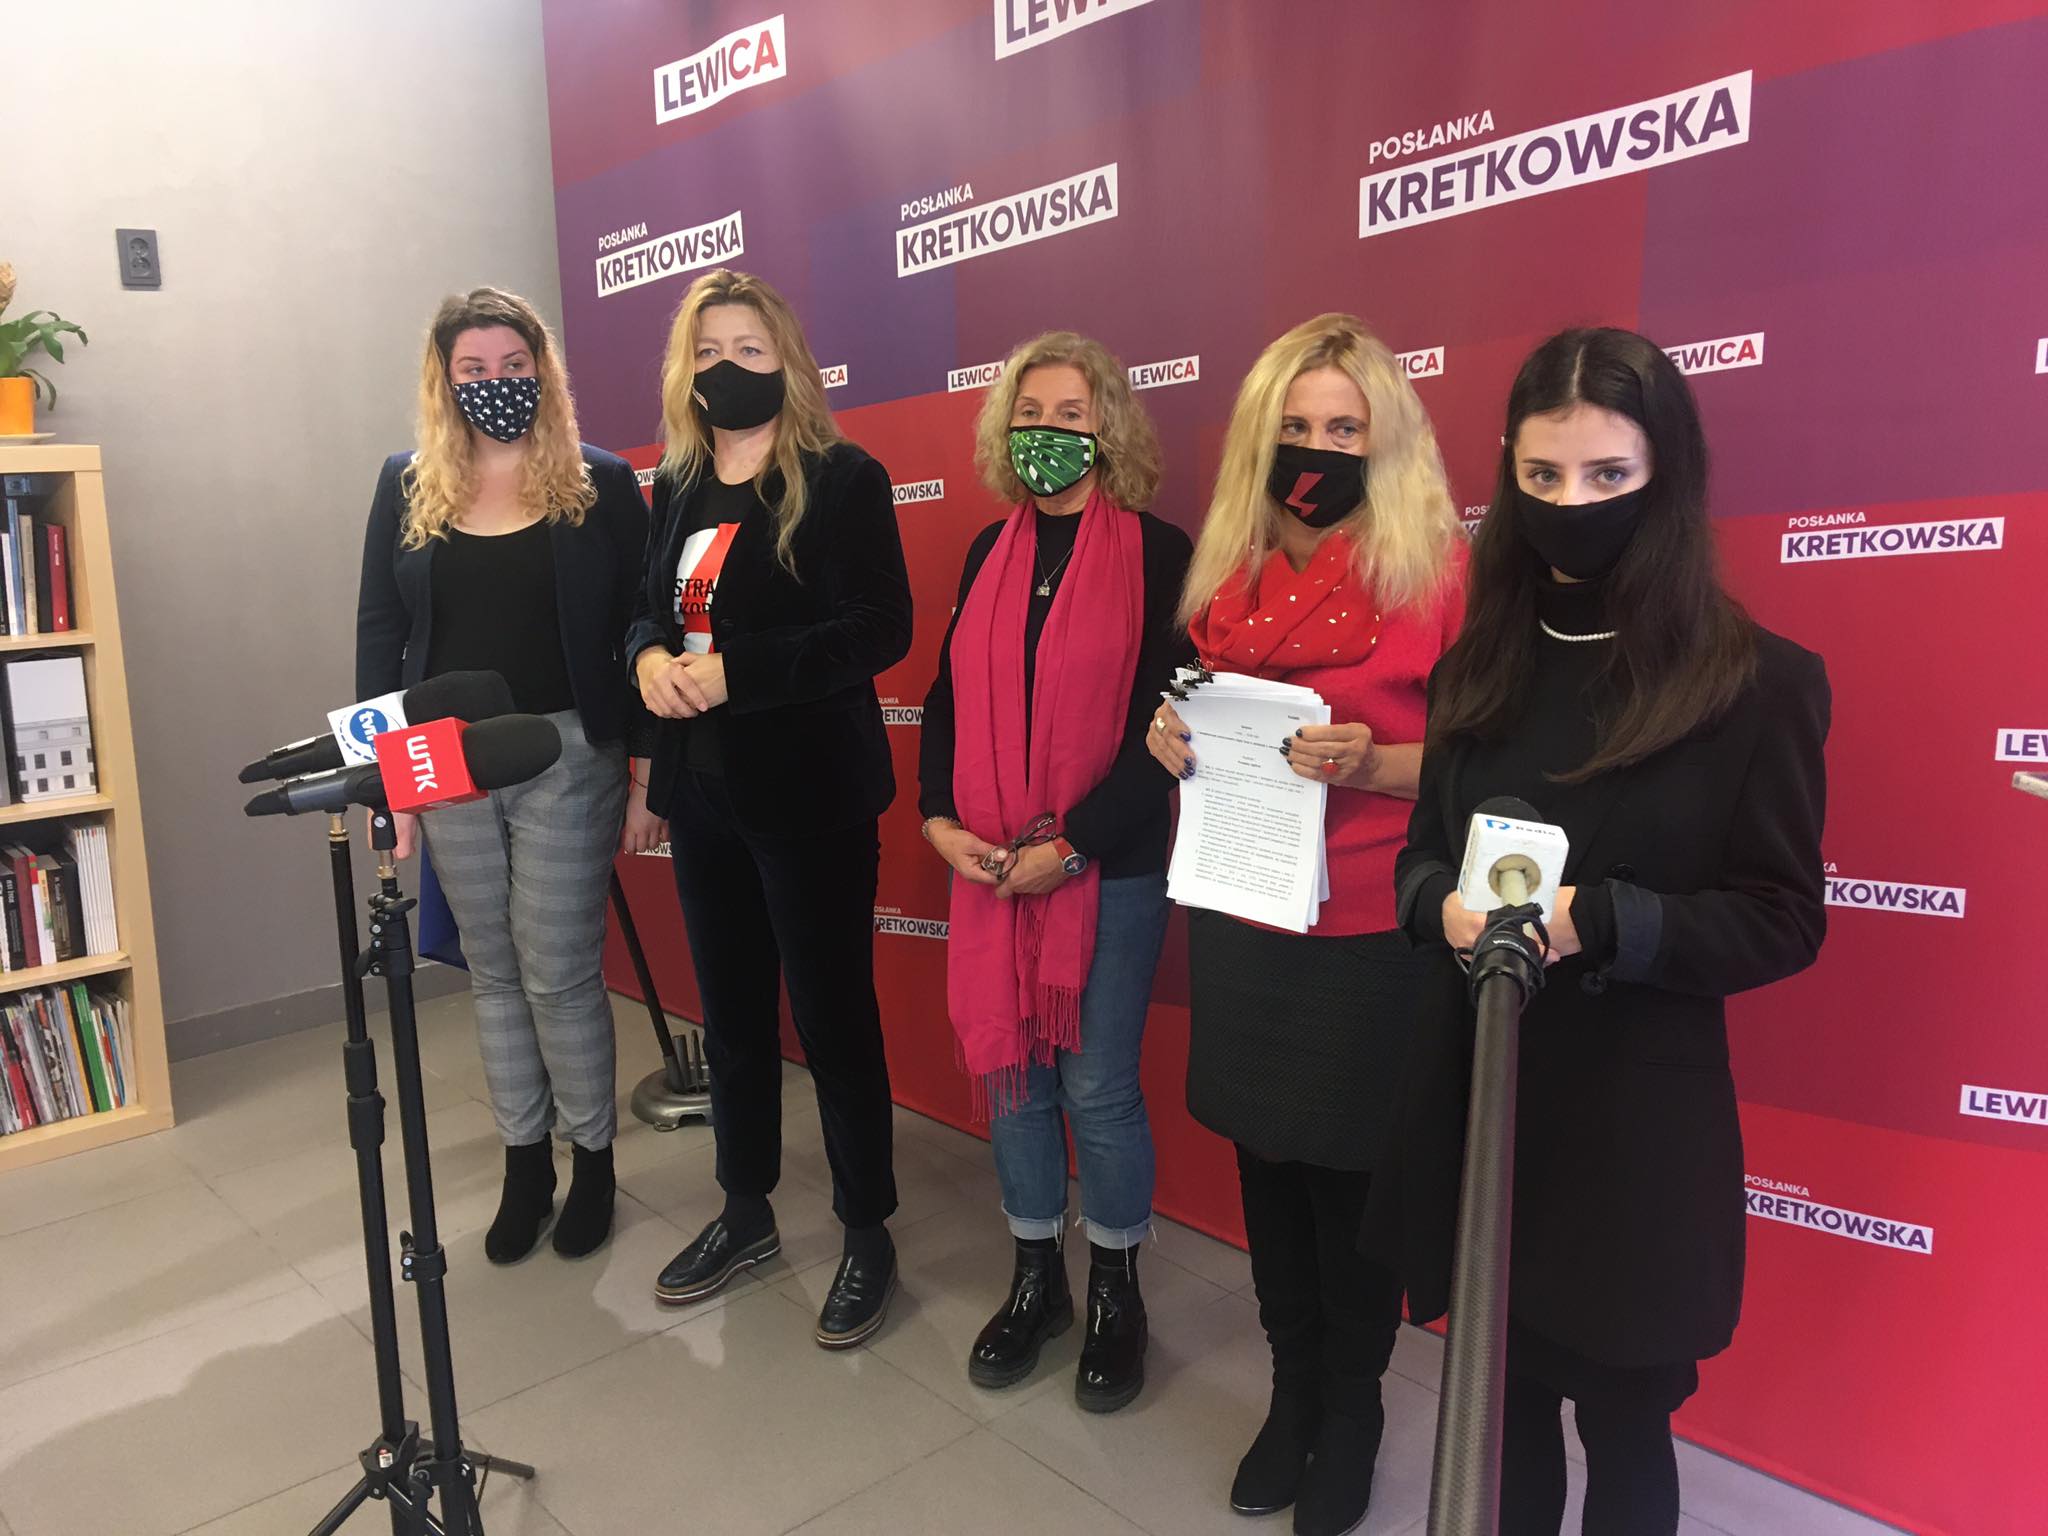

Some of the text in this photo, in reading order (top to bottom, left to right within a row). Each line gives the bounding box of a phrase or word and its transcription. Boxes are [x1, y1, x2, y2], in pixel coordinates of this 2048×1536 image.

[663, 30, 779, 112] LEWICA
[1369, 109, 1495, 164] POSŁANKA
[1368, 87, 1741, 226] KRETKOWSKA
[901, 183, 974, 221] POSŁANKA
[598, 222, 648, 251] POSŁANKA
[903, 175, 1113, 269] KRETKOWSKA
[600, 220, 741, 290] KRETKOWSKA
[821, 368, 845, 385] ICA
[951, 366, 1001, 388] LEWICA
[1132, 361, 1195, 386] LEWICA
[1398, 352, 1439, 374] ICA
[1789, 512, 1866, 528] POSŁANKA
[1787, 523, 1998, 558] KRETKOWSKA
[407, 735, 438, 793] WTK
[1968, 1090, 2047, 1120] LEWI
[1744, 1174, 1810, 1197] POSŁANKA
[1745, 1191, 1927, 1250] KRETKOWSKA
